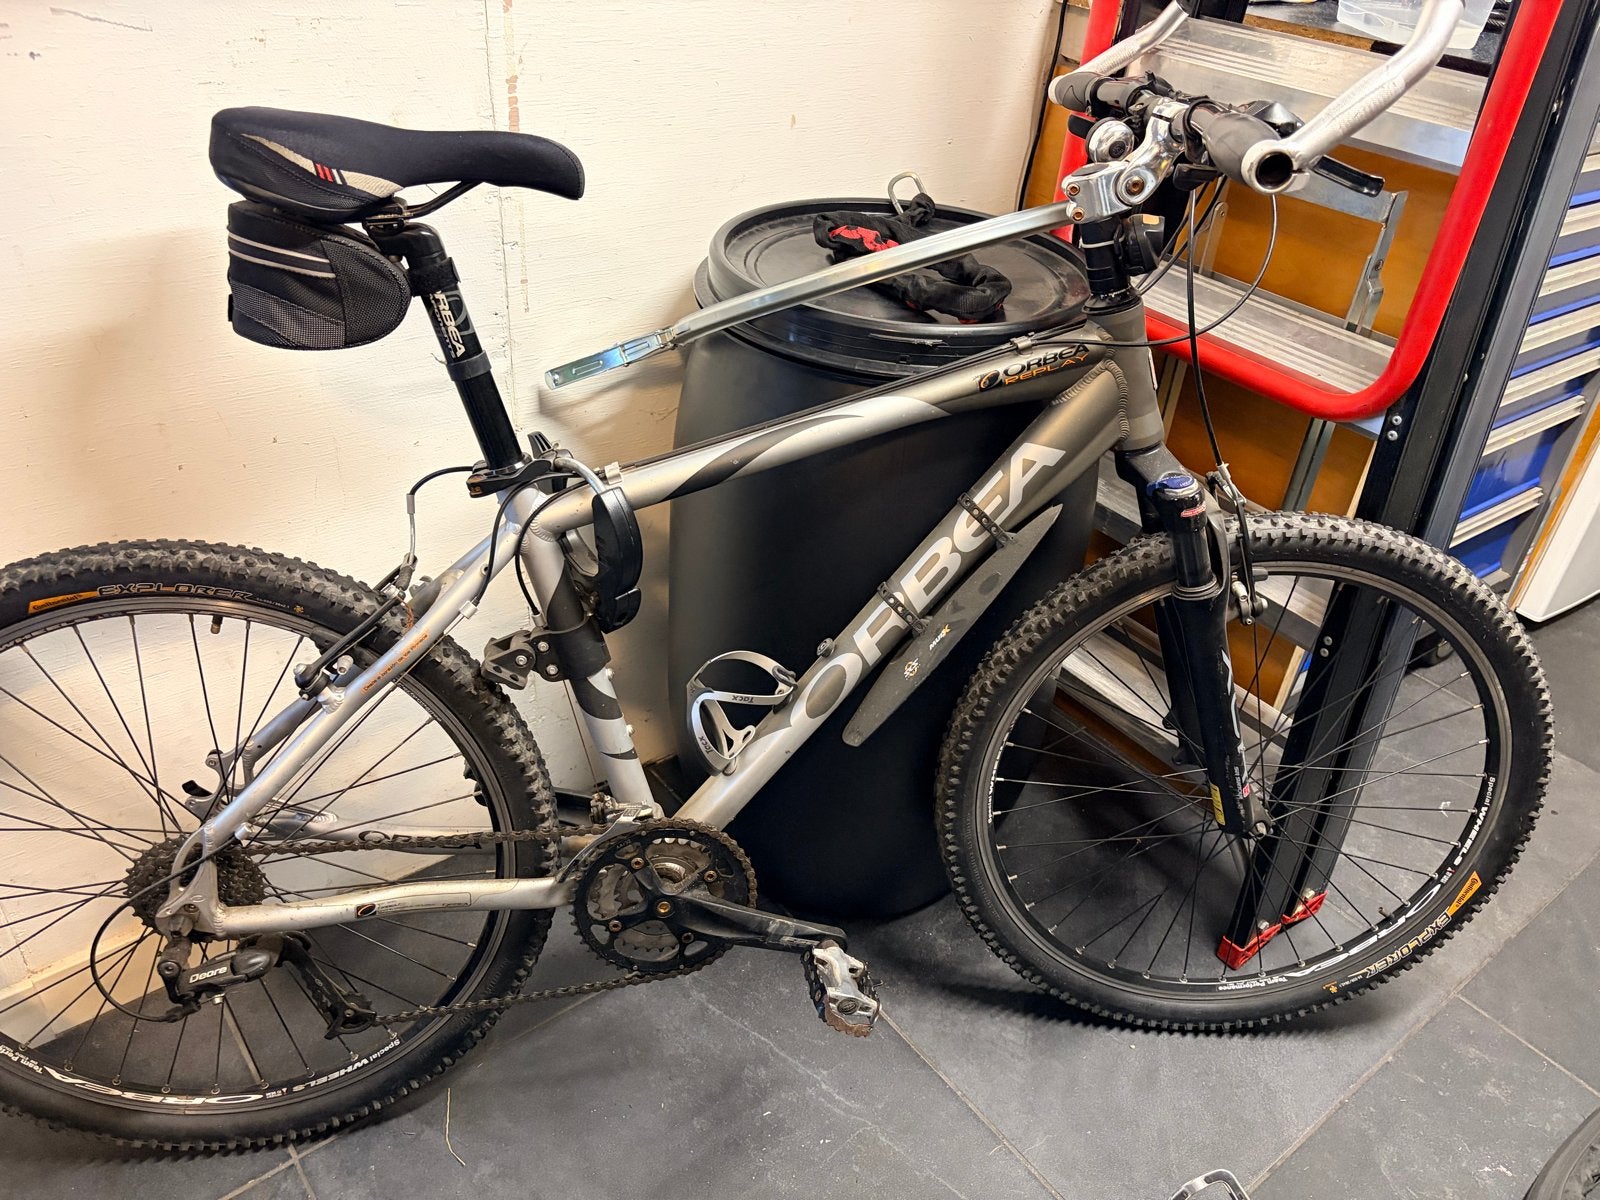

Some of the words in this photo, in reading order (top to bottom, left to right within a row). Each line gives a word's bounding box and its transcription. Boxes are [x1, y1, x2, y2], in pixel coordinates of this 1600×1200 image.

[435, 291, 465, 358] RBEA
[1003, 344, 1090, 377] ORBEA
[1005, 353, 1089, 385] REPLAY
[97, 582, 254, 601] EXPLORER
[790, 443, 1066, 727] ORBEA
[732, 694, 754, 704] Tacx
[698, 735, 714, 755] Tacx
[1484, 776, 1496, 806] Special
[1453, 806, 1489, 866] WHEELS
[1366, 910, 1452, 979] EXPLORER
[189, 966, 228, 984] Deore
[0, 1044, 19, 1062] Perf
[369, 1038, 401, 1062] Special
[19, 1057, 43, 1074] Team
[292, 1058, 370, 1092] WHEELS
